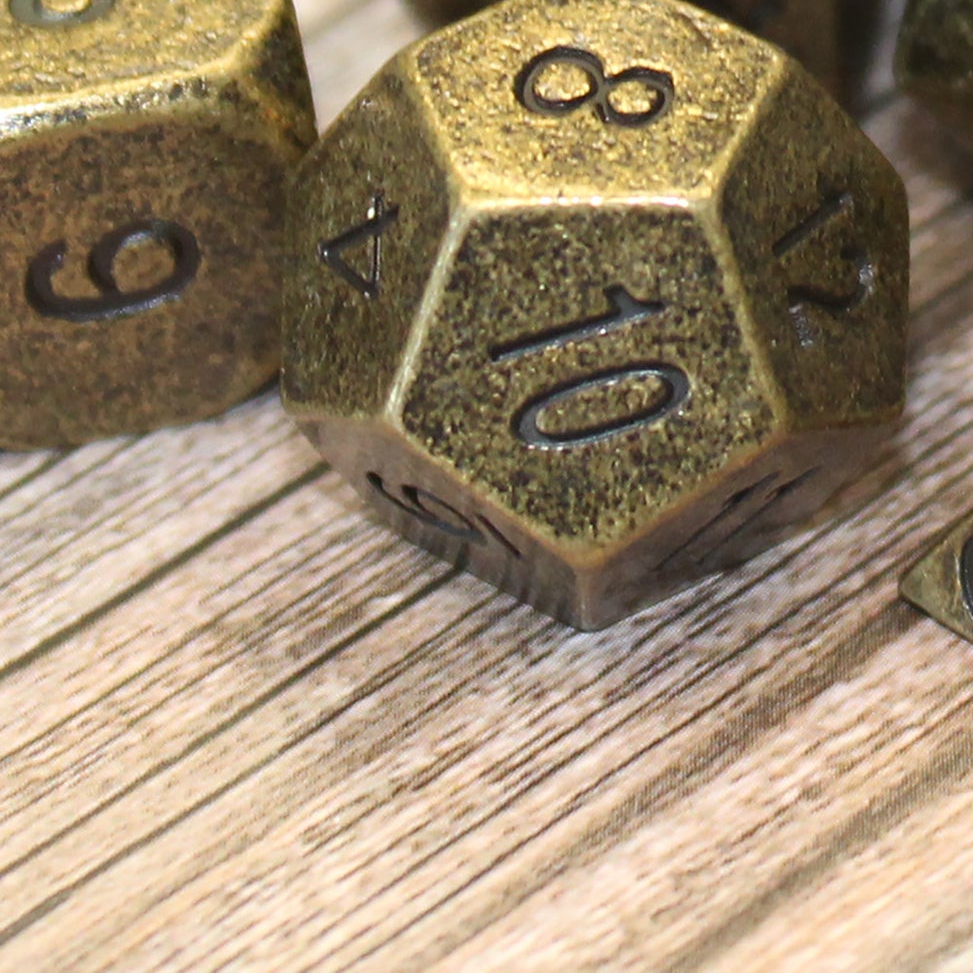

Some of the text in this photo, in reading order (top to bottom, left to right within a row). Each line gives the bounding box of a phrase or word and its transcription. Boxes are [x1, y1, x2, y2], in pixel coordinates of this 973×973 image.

[513, 45, 676, 125] 8
[317, 187, 401, 300] 4
[772, 173, 877, 347] 12
[490, 284, 691, 451] 10
